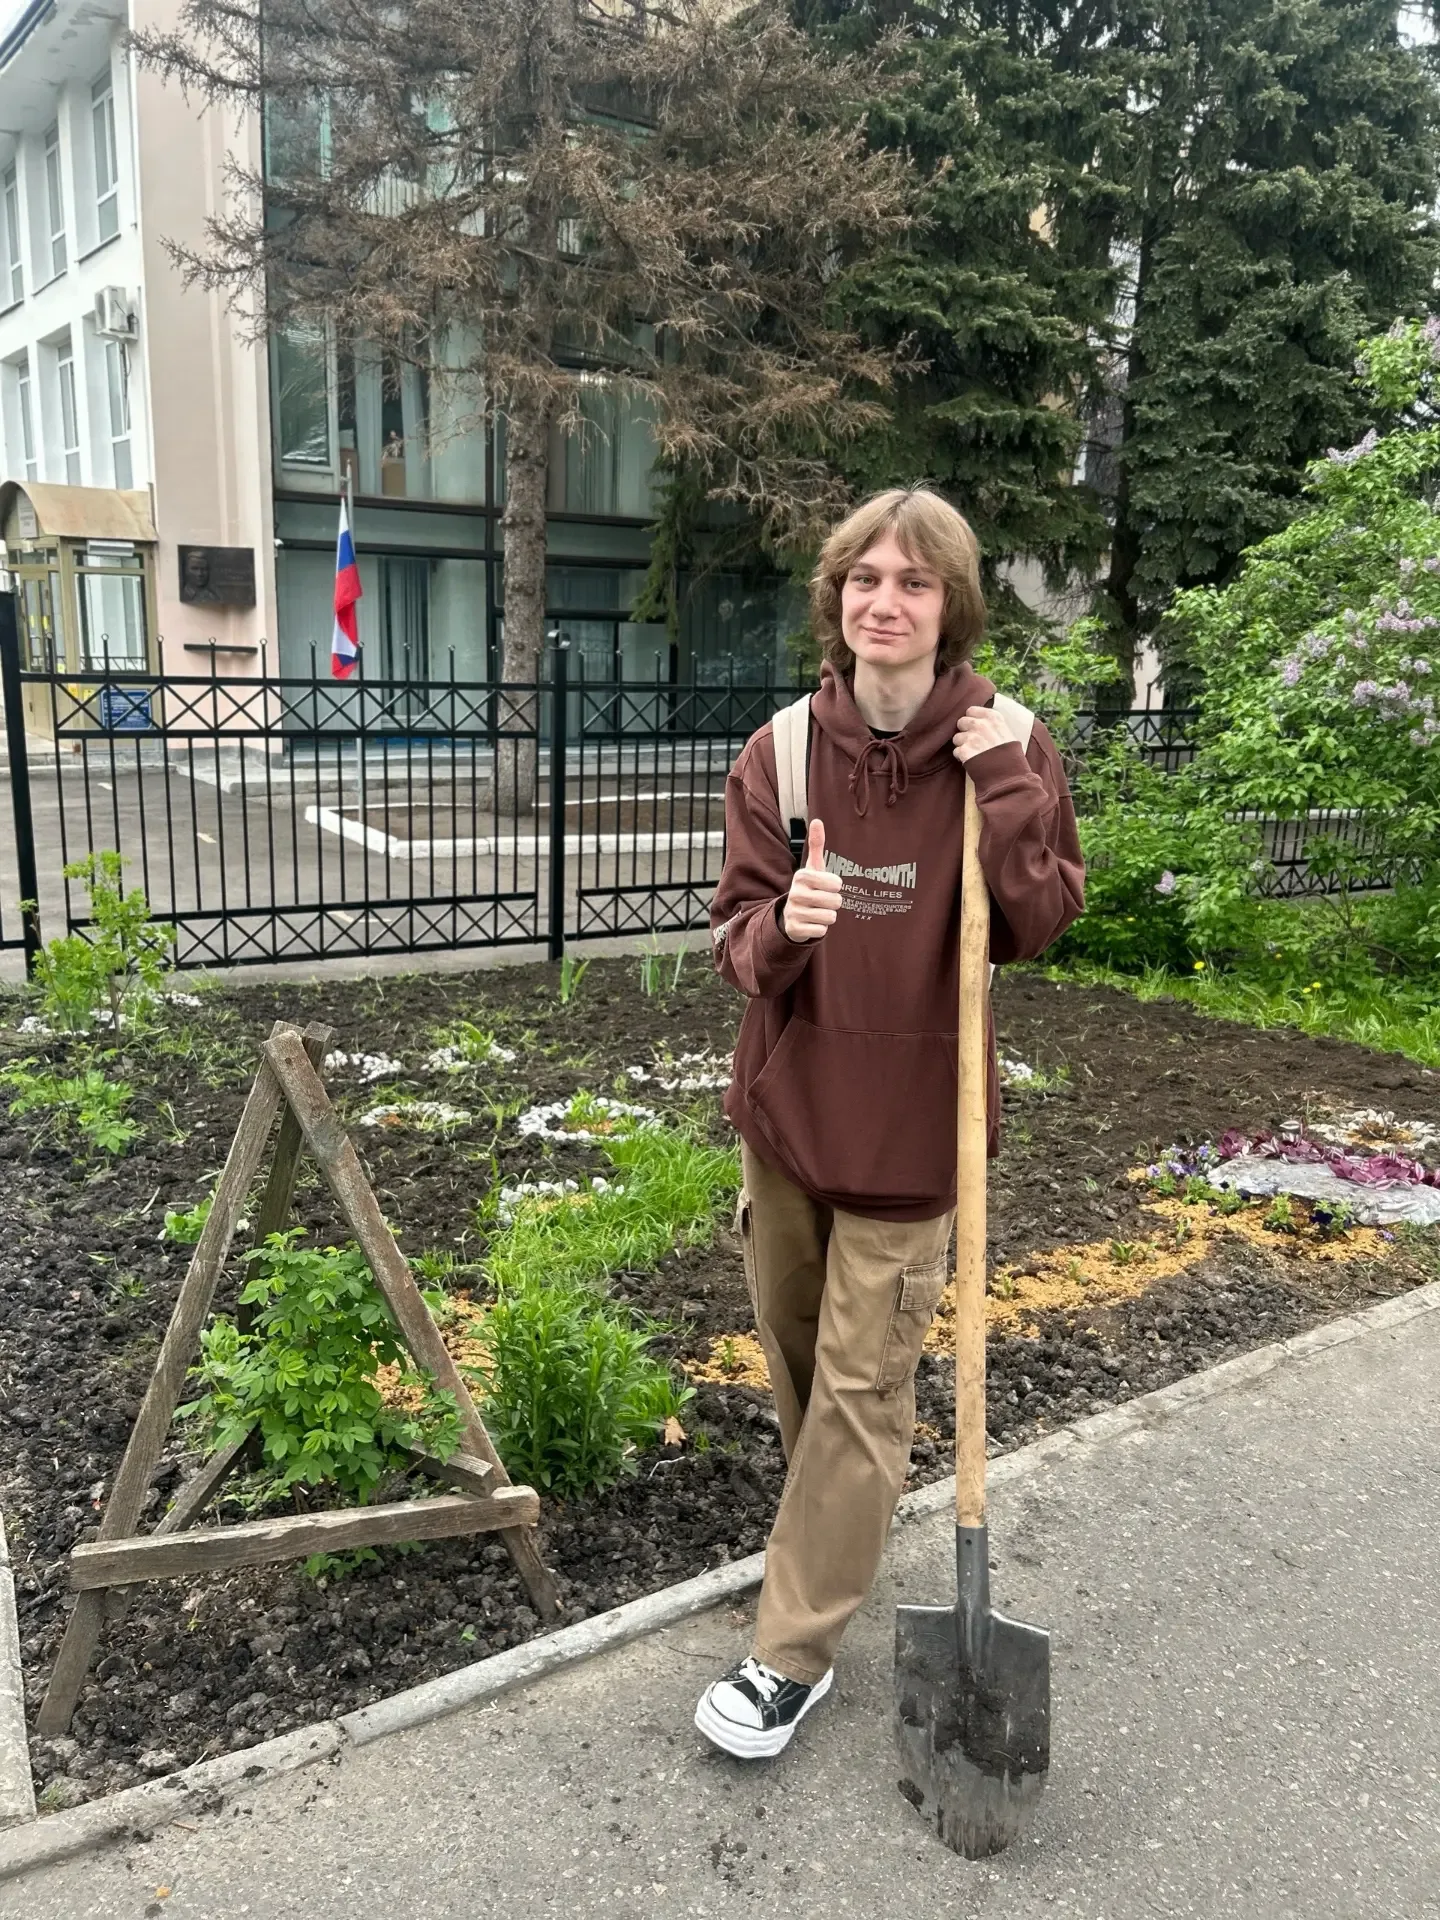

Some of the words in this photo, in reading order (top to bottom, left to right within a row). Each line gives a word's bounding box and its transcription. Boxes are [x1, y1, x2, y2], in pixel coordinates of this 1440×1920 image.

[864, 861, 917, 889] GROWTH
[840, 883, 870, 896] NREAL
[873, 890, 903, 898] LIFES
